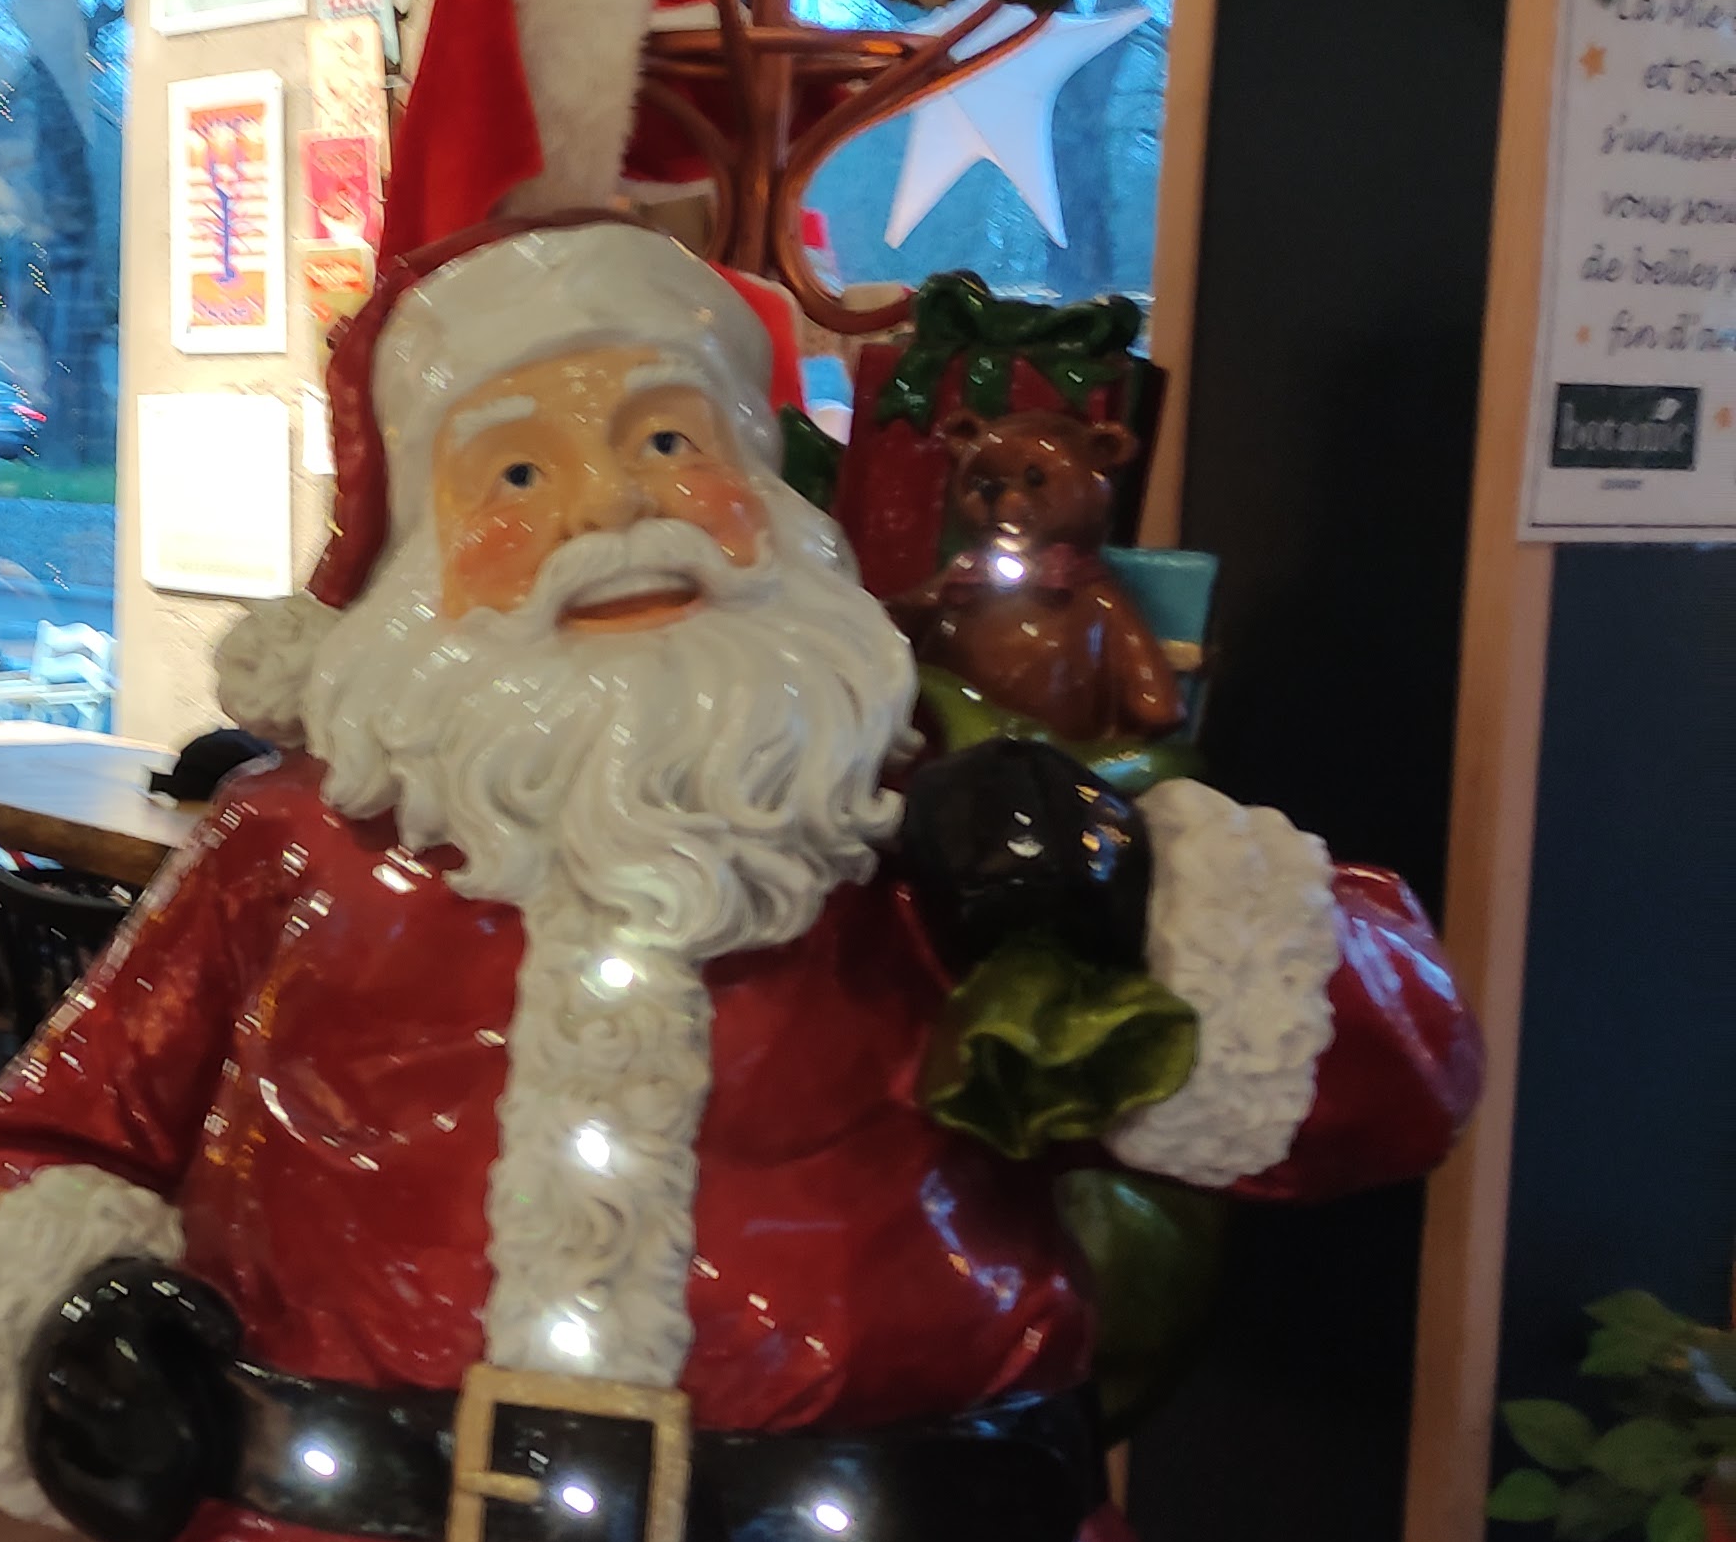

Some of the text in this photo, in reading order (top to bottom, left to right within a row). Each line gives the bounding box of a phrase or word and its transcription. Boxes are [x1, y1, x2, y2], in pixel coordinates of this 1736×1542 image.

[1643, 57, 1672, 90] et
[1601, 190, 1672, 224] vous
[1580, 243, 1718, 290] de belles
[1608, 309, 1658, 356] fin
[1559, 401, 1689, 452] botanic
